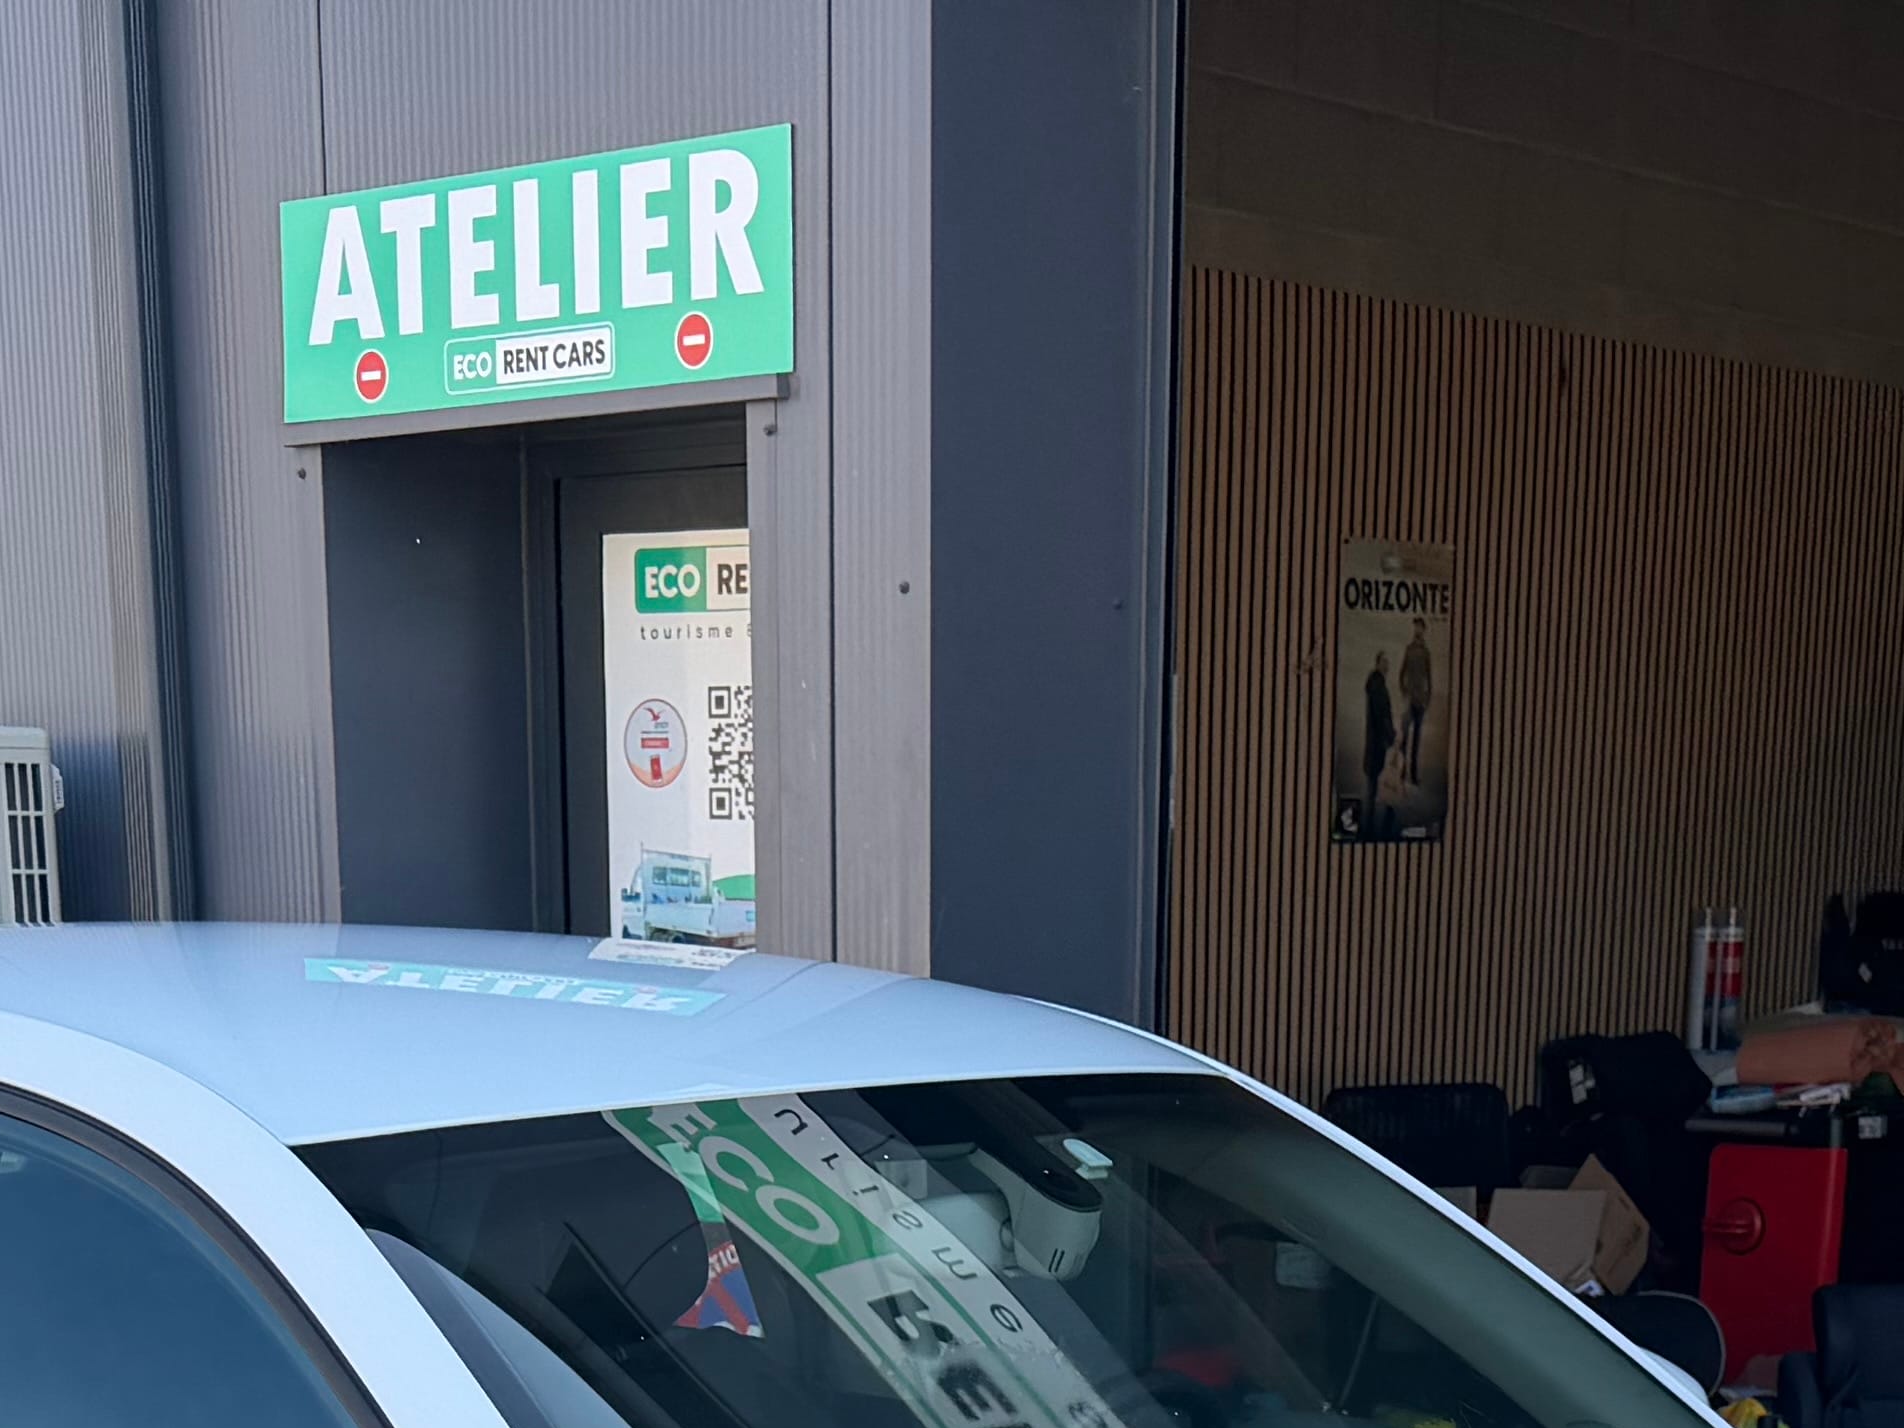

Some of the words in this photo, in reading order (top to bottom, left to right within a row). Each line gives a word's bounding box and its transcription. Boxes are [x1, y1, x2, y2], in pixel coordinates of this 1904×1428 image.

[308, 149, 764, 345] ATELIER
[453, 351, 492, 381] ECO
[503, 346, 548, 375] RENT
[553, 339, 606, 369] CARS
[645, 564, 700, 598] ECO
[1345, 578, 1448, 613] ORIZONTE
[640, 624, 733, 640] tourisme
